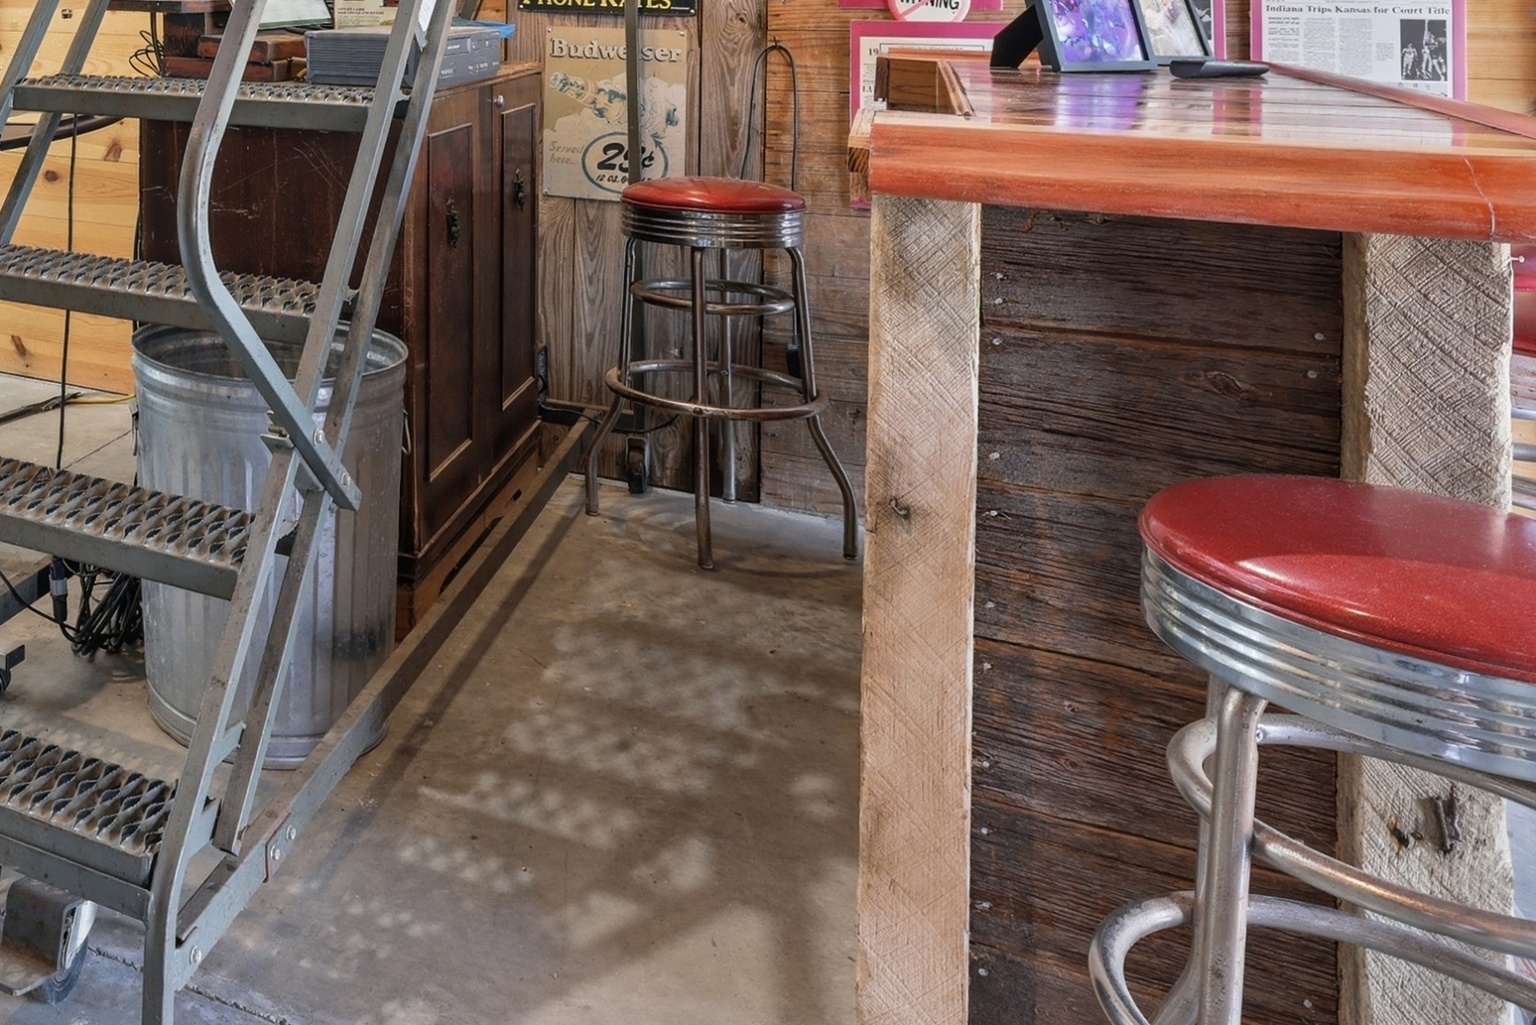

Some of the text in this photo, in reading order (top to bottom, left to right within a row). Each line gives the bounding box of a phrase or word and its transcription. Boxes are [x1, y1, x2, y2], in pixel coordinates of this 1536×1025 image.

[1265, 4, 1303, 13] Indiana
[1307, 5, 1332, 15] Trips
[1335, 5, 1371, 15] Kansas
[1373, 6, 1389, 15] for
[1392, 6, 1423, 15] Court
[550, 37, 683, 63] Budweser
[869, 47, 880, 56] 19
[548, 140, 583, 155] Served
